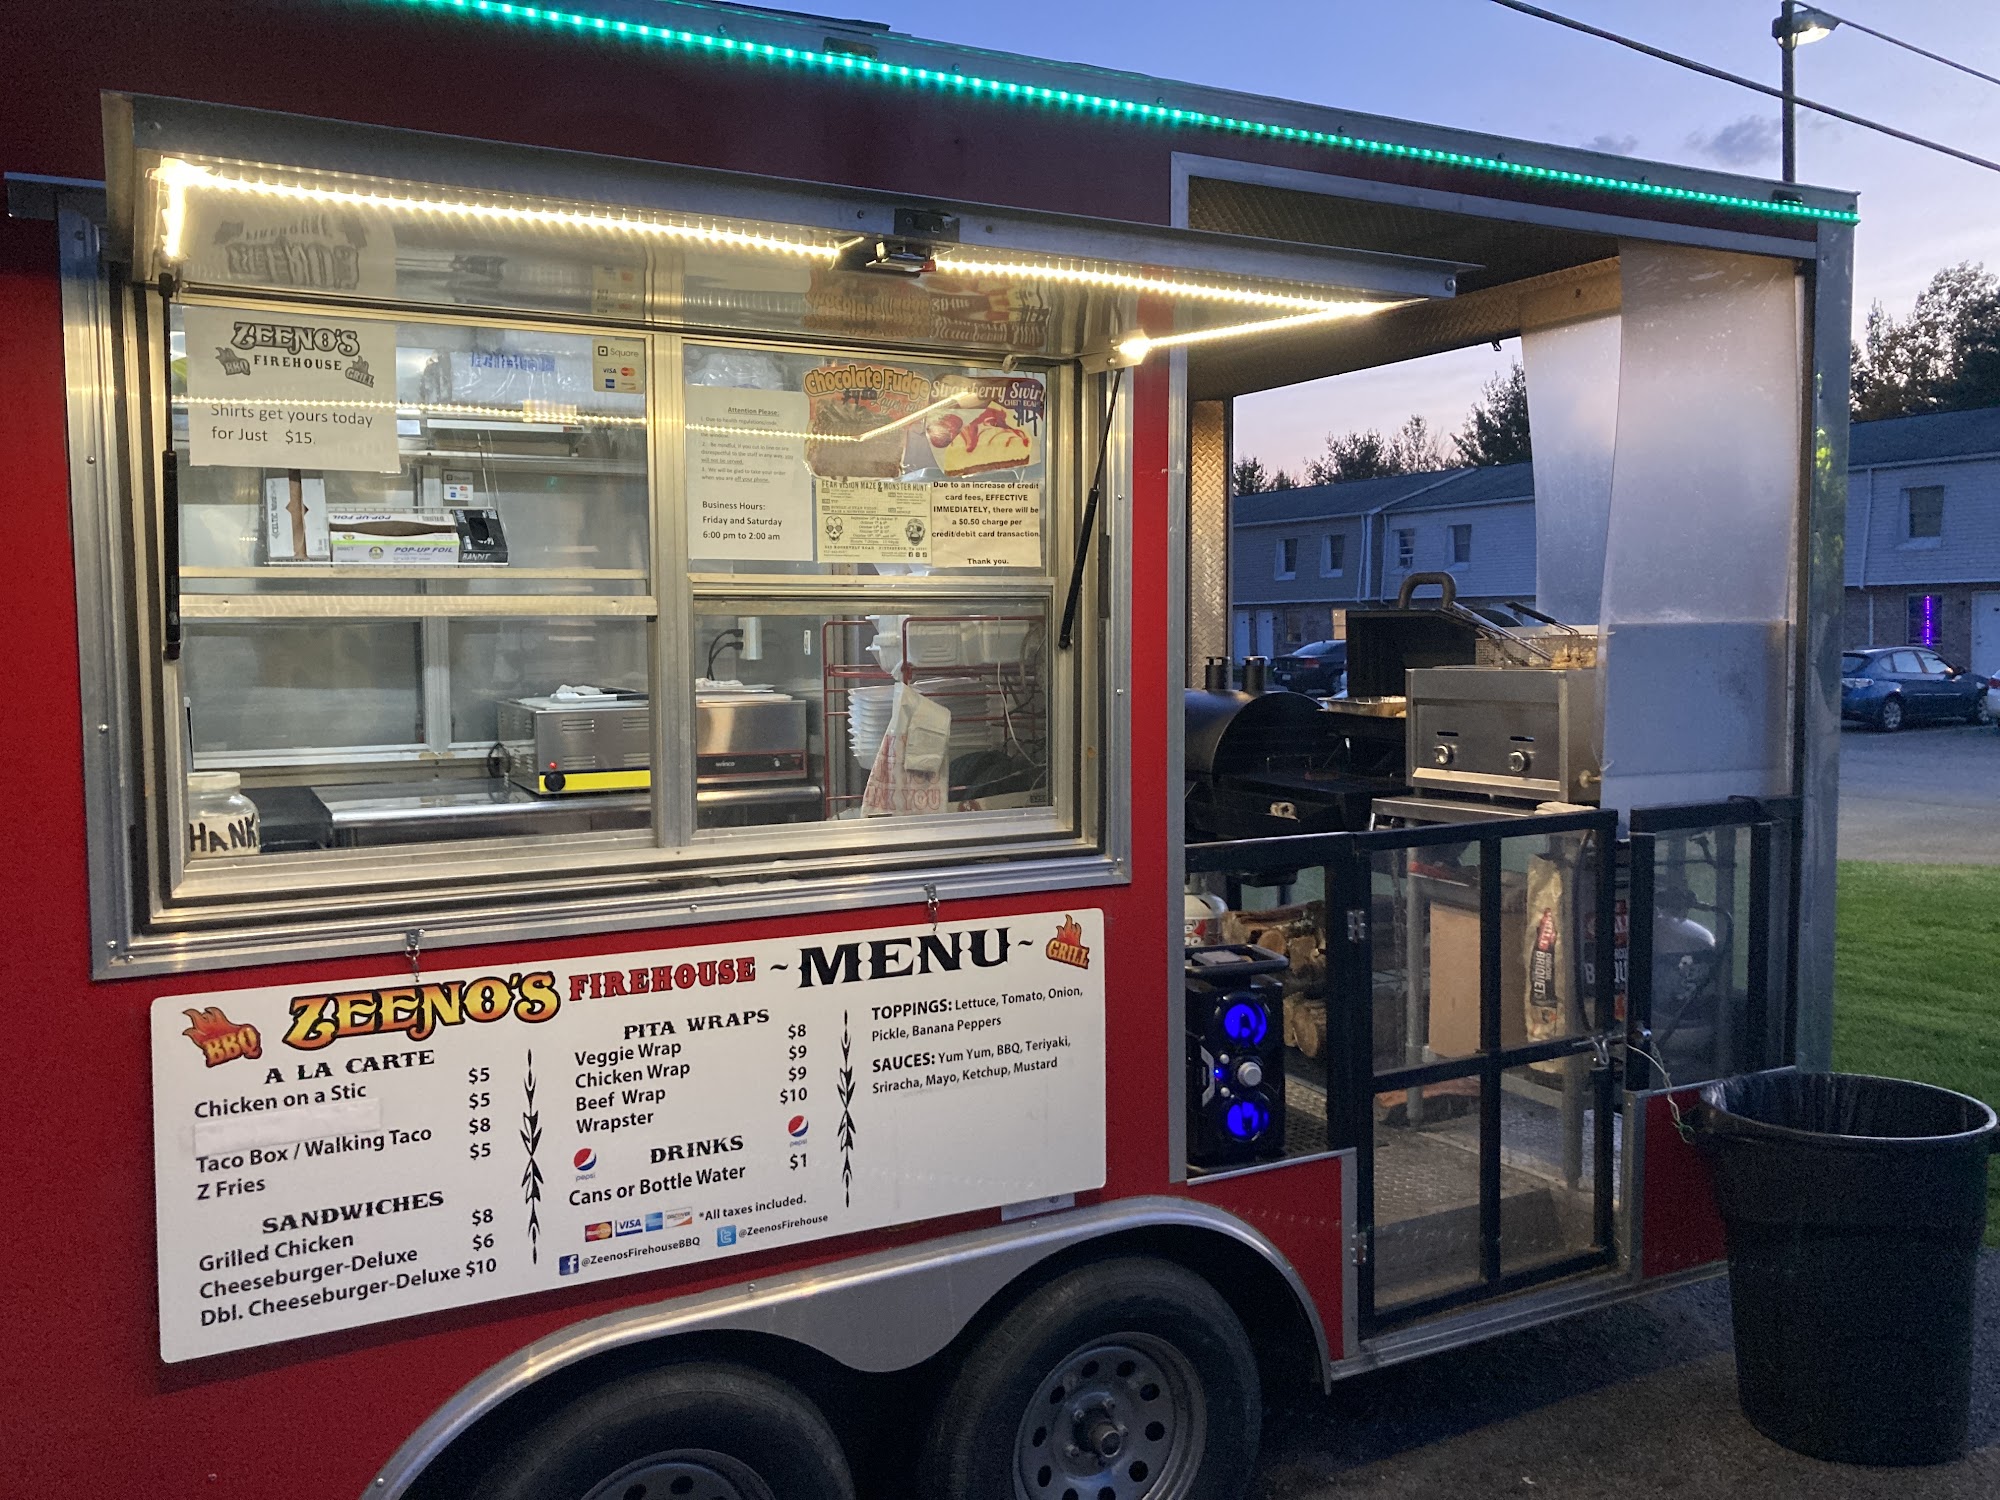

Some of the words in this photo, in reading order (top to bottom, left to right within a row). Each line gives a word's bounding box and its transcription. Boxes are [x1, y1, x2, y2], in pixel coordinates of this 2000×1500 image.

[231, 322, 360, 356] ZEENO'S
[254, 354, 342, 371] FIREHOUSE
[610, 347, 639, 358] Square
[225, 357, 251, 376] BBQ
[345, 367, 374, 387] GRILL
[805, 365, 882, 394] Chocolate
[883, 369, 930, 400] Fudge
[1009, 381, 1045, 402] Swirl
[211, 404, 254, 418] Shirts
[259, 408, 283, 421] get
[288, 410, 328, 425] yours
[332, 413, 373, 428] today
[728, 406, 757, 414] Attention
[211, 427, 235, 440] for
[238, 429, 268, 442] Just
[821, 480, 838, 488] FEAR
[878, 482, 883, 492] &
[883, 483, 911, 491] MONSTER
[912, 483, 927, 491] HUNT
[702, 501, 738, 510] Business
[739, 502, 766, 511] Hours:
[933, 506, 991, 514] IMMEDIATELY,
[702, 516, 729, 526] Friday
[730, 517, 745, 525] and
[747, 517, 782, 527] Saturday
[702, 531, 720, 539] 6:00
[723, 533, 736, 541] pm
[749, 532, 766, 540] 2:00
[462, 553, 492, 561] BANDIT
[902, 788, 941, 811] YOU
[1046, 939, 1090, 970] GRILL
[282, 972, 562, 1051] ZEENO'S
[568, 957, 758, 1002] FIREHOUSE
[797, 926, 1012, 989] MENU
[871, 998, 953, 1021] TOPPINGS:
[955, 995, 1000, 1012] Lettuce,
[1002, 990, 1047, 1006] Tomato,
[1048, 985, 1084, 1000] Onion,
[624, 1020, 677, 1040] PITA
[687, 1009, 770, 1033] WRAPS
[788, 1024, 807, 1040] $8
[871, 1027, 910, 1043] Pickle,
[912, 1022, 954, 1038] Banana
[957, 1016, 1002, 1034] Peppers
[203, 1025, 261, 1067] BBQ
[575, 1046, 634, 1068] Veggie
[637, 1041, 682, 1060] Wrap
[788, 1045, 807, 1061] $9
[872, 1053, 935, 1074] SAUCES:
[938, 1050, 964, 1066] Yum
[966, 1046, 995, 1062] Yum,
[996, 1042, 1023, 1057] BBQ,
[1025, 1036, 1071, 1054] Teriyaki,
[264, 1068, 286, 1085] A
[297, 1062, 334, 1081] LA
[345, 1050, 435, 1074] CARTE
[468, 1066, 491, 1084] $5
[575, 1069, 643, 1089] Chicken
[646, 1062, 691, 1080] Wrap
[788, 1066, 807, 1082] $9
[872, 1078, 923, 1095] Sriracha,
[925, 1071, 960, 1088] Mayo,
[962, 1066, 1012, 1083] Ketchup,
[1013, 1057, 1058, 1074] Mustard
[194, 1092, 278, 1118] Chicken
[283, 1090, 309, 1107] on
[314, 1090, 326, 1103] a
[331, 1082, 367, 1101] Stic
[469, 1092, 491, 1110] $5
[576, 1092, 615, 1112] Beef
[621, 1086, 666, 1106] Wrap
[780, 1087, 808, 1105] $10
[469, 1118, 491, 1135] $8
[576, 1110, 654, 1134] Wrapster
[196, 1153, 244, 1173] Taco
[250, 1146, 288, 1166] Box
[305, 1133, 385, 1158] Walking
[389, 1127, 432, 1145] Taco
[470, 1143, 491, 1160] $5
[650, 1135, 744, 1164] DRINKS
[789, 1138, 808, 1148] pepsi
[790, 1153, 808, 1170] $1
[197, 1184, 211, 1200] Z
[216, 1176, 266, 1197] Fries
[569, 1188, 612, 1206] Cans
[616, 1183, 635, 1198] or
[640, 1172, 693, 1195] Bottle
[695, 1165, 746, 1185] Water
[575, 1172, 597, 1183] pepsi
[262, 1190, 445, 1234] SANDWICHES
[472, 1208, 494, 1227] $8
[722, 1205, 753, 1218] taxes
[755, 1194, 807, 1212] included.
[619, 1218, 642, 1230] VISA
[738, 1213, 829, 1239] @ZeenosFirehouse
[199, 1245, 270, 1272] Grilled
[274, 1233, 354, 1260] Chicken
[472, 1233, 494, 1252] $6
[581, 1236, 701, 1268] @ZeenosFirehouseBBQ
[200, 1249, 418, 1299] Cheeseburger-Deluxe
[465, 1257, 497, 1279] $10
[201, 1304, 243, 1327] Dbl.
[248, 1264, 461, 1318] Cheeseburger-Deluxe
